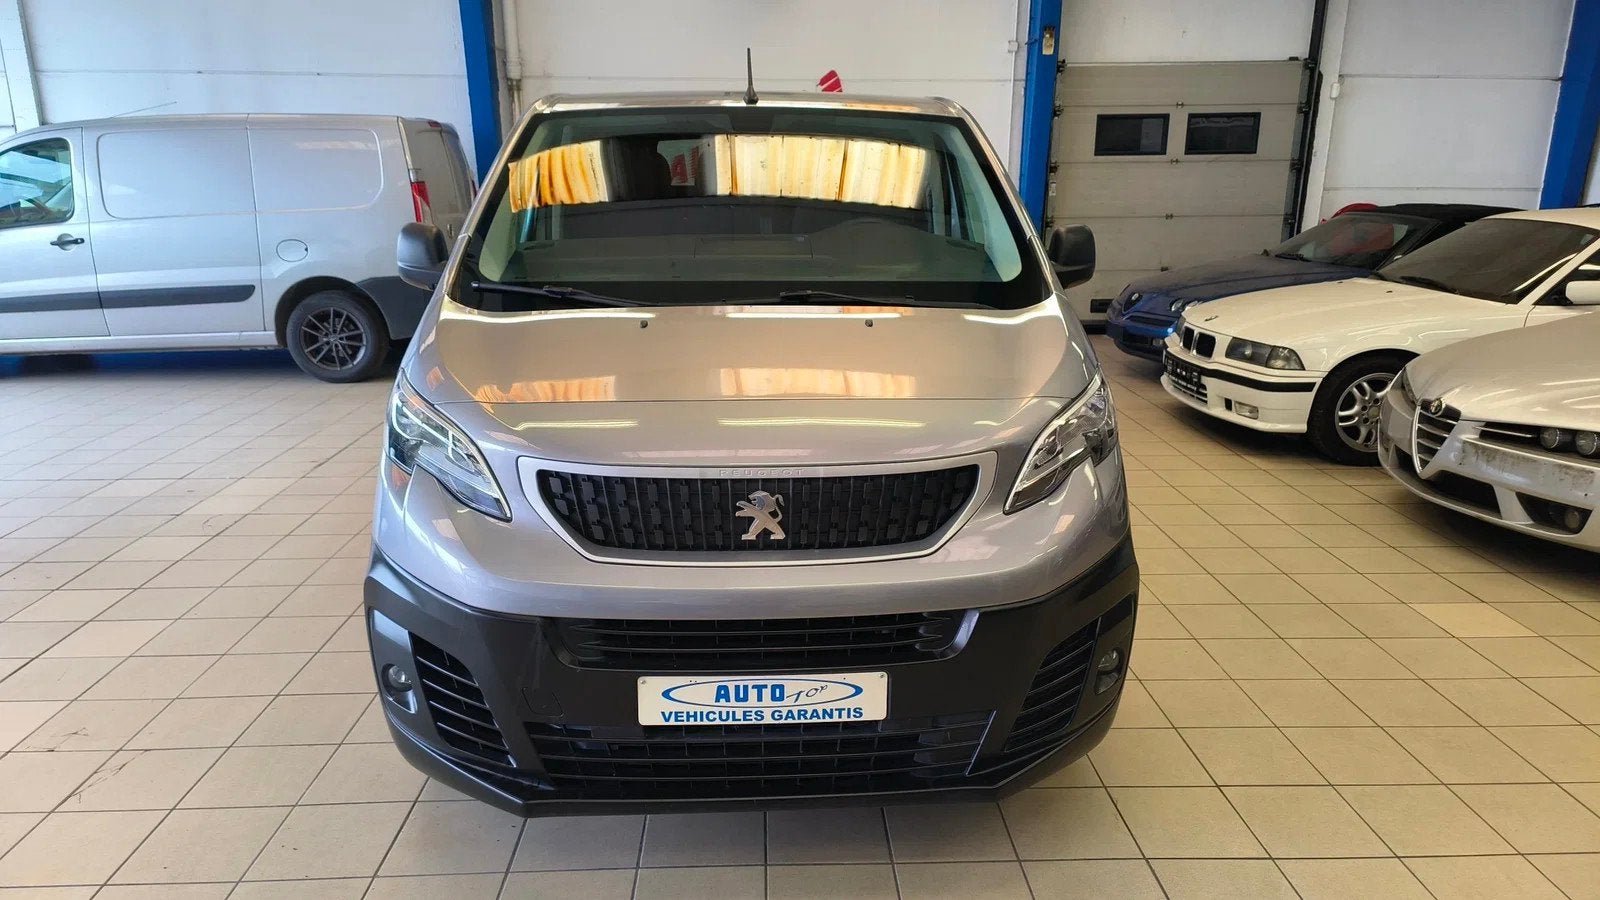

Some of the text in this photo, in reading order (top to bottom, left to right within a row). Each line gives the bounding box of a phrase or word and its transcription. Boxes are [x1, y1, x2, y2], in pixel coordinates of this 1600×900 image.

[718, 468, 805, 477] PEUGEOT
[714, 683, 785, 703] AUTO
[661, 707, 864, 723] VEHICULES GARANTIS
